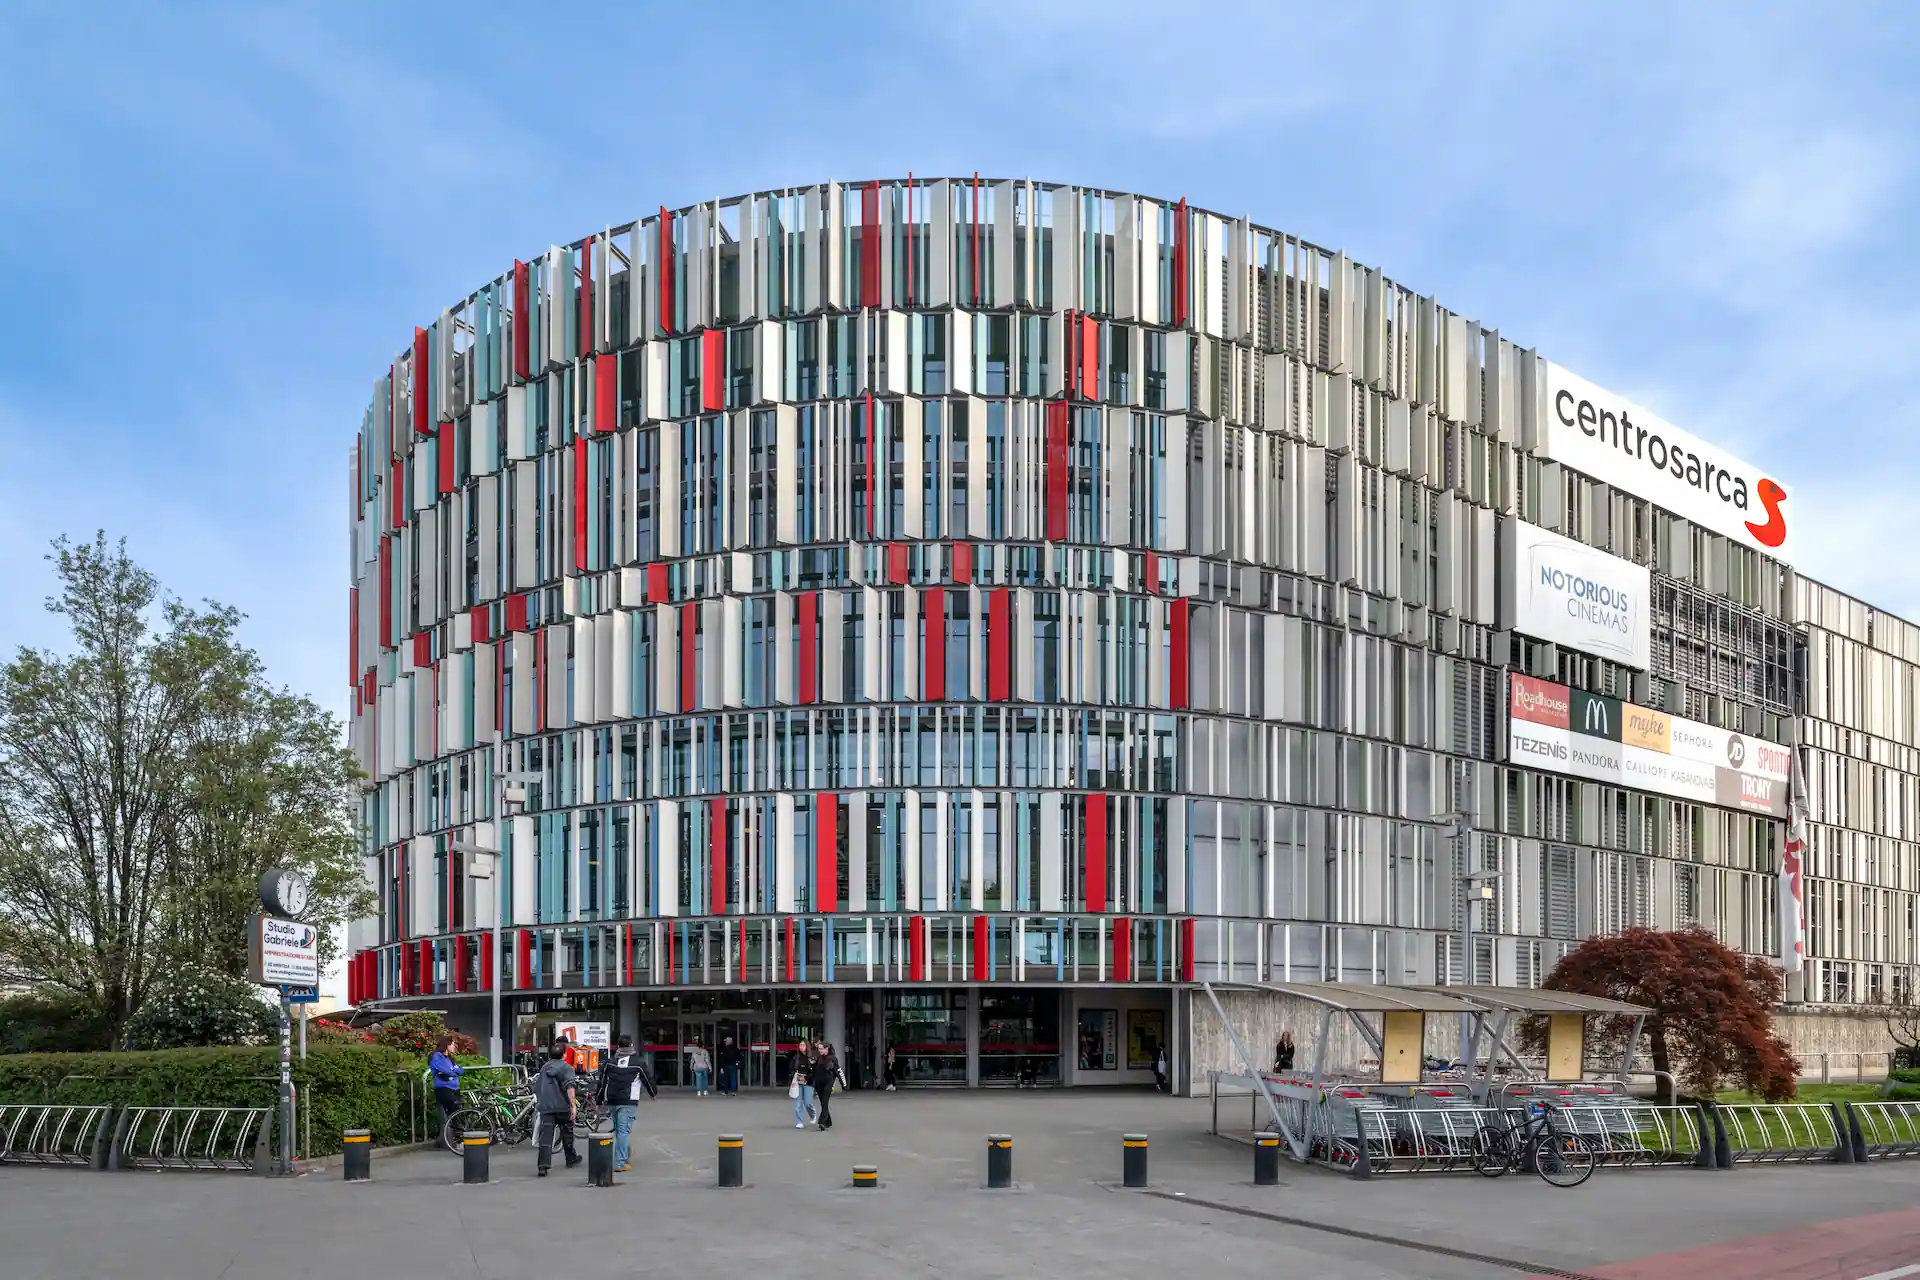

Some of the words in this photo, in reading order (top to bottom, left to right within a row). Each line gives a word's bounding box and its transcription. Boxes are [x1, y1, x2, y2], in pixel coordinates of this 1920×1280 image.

[1555, 389, 1748, 511] centrosarca
[1541, 565, 1628, 612] NOTORIOUS
[1567, 598, 1628, 634] CINEMAS
[1514, 683, 1568, 712] Roadhouse
[1513, 735, 1568, 760] TEZENIS
[1673, 731, 1713, 750] SEPHORA
[1728, 741, 1744, 761] JD
[1572, 750, 1620, 770] PANDORA
[1625, 760, 1667, 778] CALLIOPE
[1757, 746, 1792, 776] SPONTIN
[1741, 774, 1771, 800] TRONY
[263, 933, 299, 948] Gabriele
[267, 921, 296, 935] Studio
